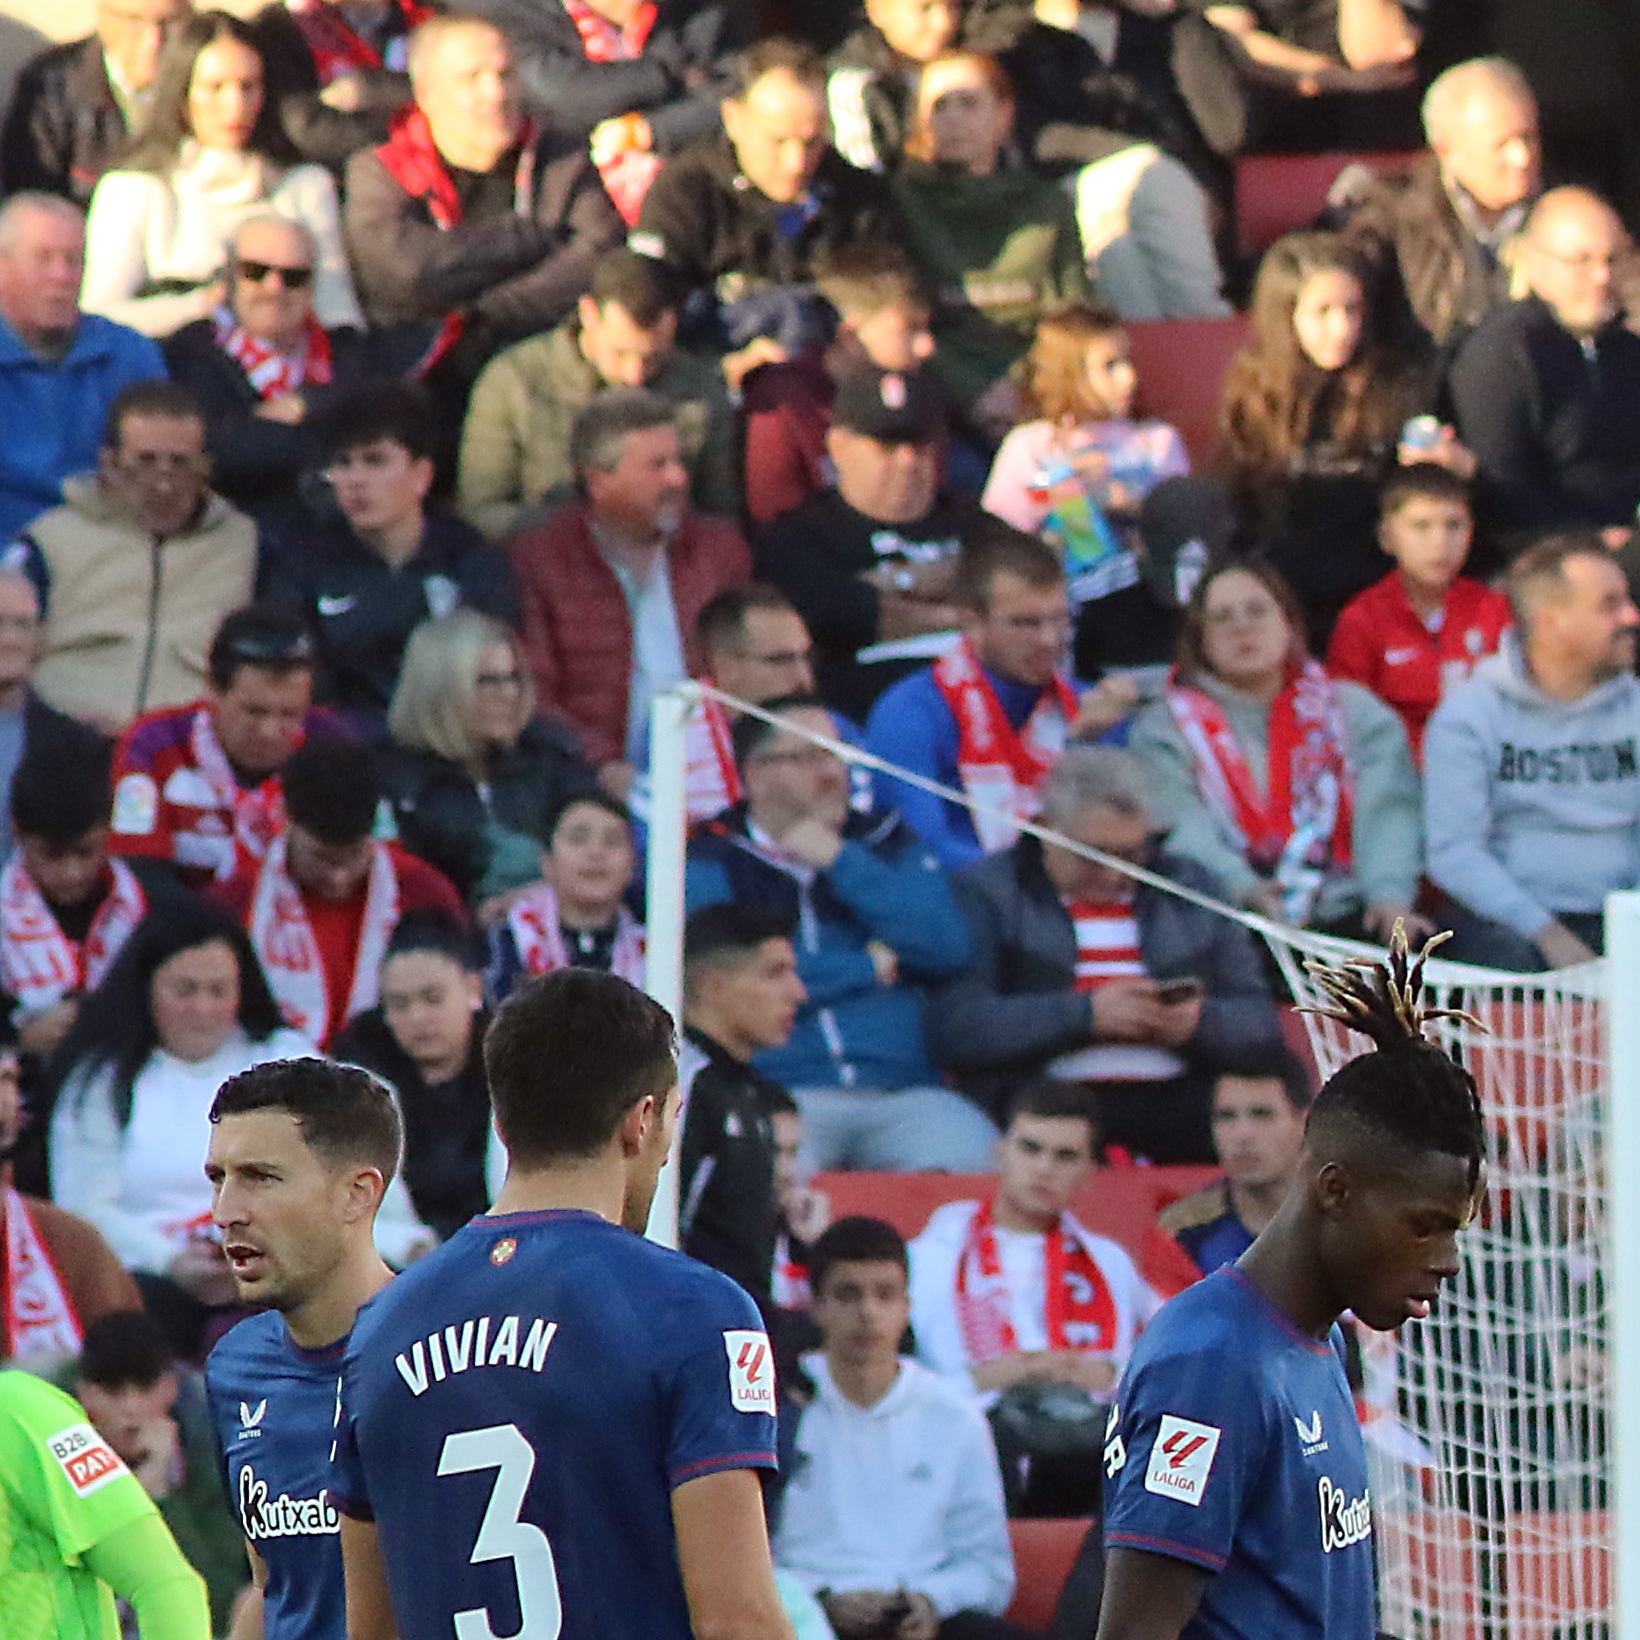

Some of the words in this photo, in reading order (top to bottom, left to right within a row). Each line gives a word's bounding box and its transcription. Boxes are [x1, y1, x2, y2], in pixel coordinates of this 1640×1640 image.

[1499, 735, 1637, 783] BOSTON
[395, 1316, 558, 1396] VIVIAN
[1153, 1470, 1196, 1493] LALIGA
